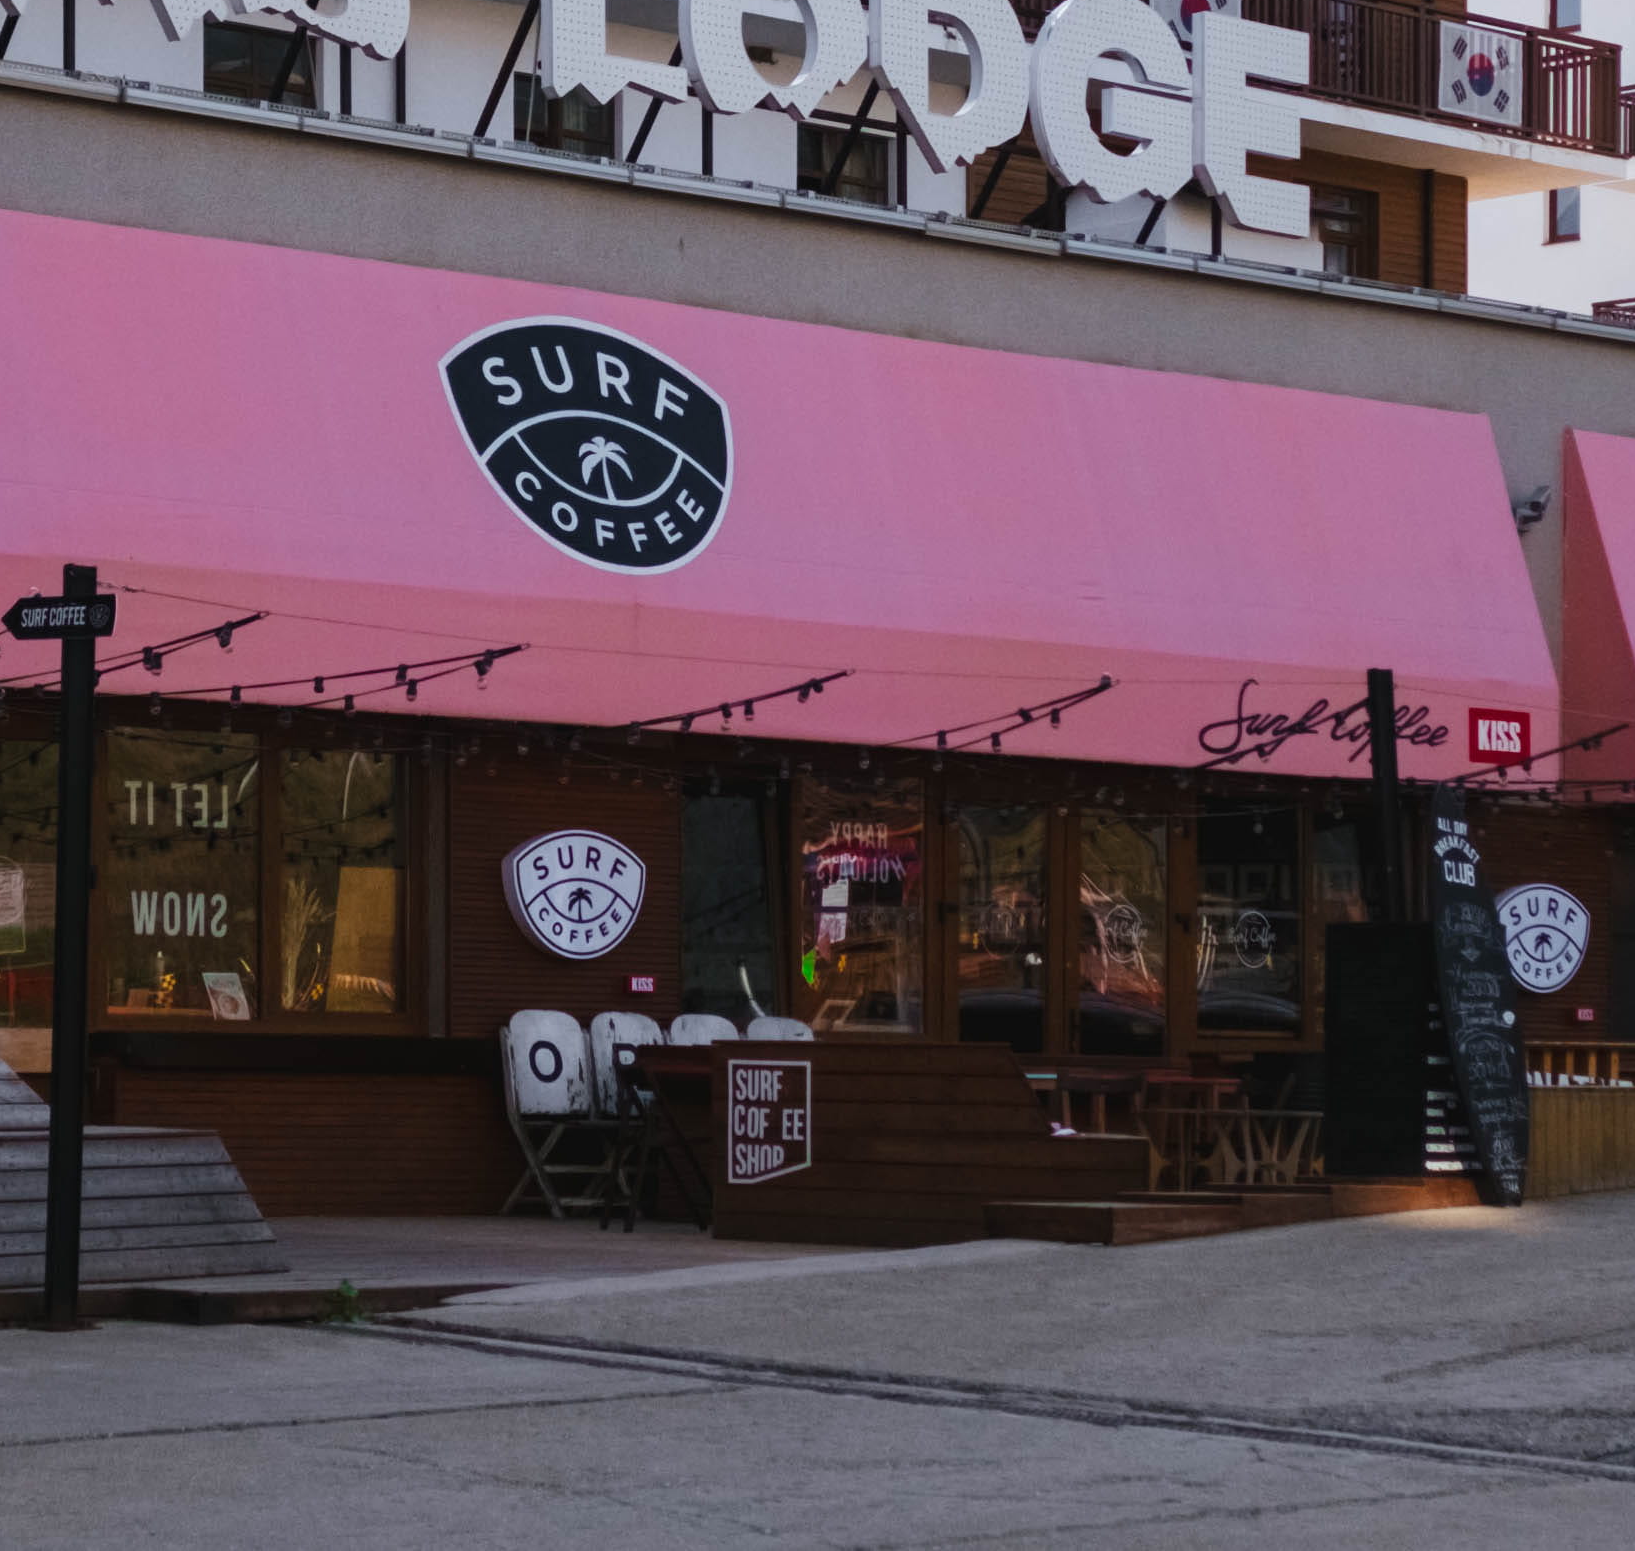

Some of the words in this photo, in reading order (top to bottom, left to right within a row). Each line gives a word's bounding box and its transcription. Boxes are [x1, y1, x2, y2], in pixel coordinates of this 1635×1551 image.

[482, 346, 689, 421] SURF
[515, 471, 705, 553] COFFEE
[20, 608, 48, 628] SURF
[49, 606, 87, 627] COFFEE
[1199, 679, 1329, 761] Surf
[1477, 718, 1522, 754] KISS
[1437, 817, 1452, 833] ALL
[533, 845, 627, 880] SURF
[1443, 860, 1476, 887] CLUB
[538, 907, 622, 944] COFFEE
[1510, 897, 1577, 926] SURF
[1513, 949, 1573, 980] COFFEE
[735, 1069, 783, 1102] SURF
[735, 1145, 784, 1176] SHOP
